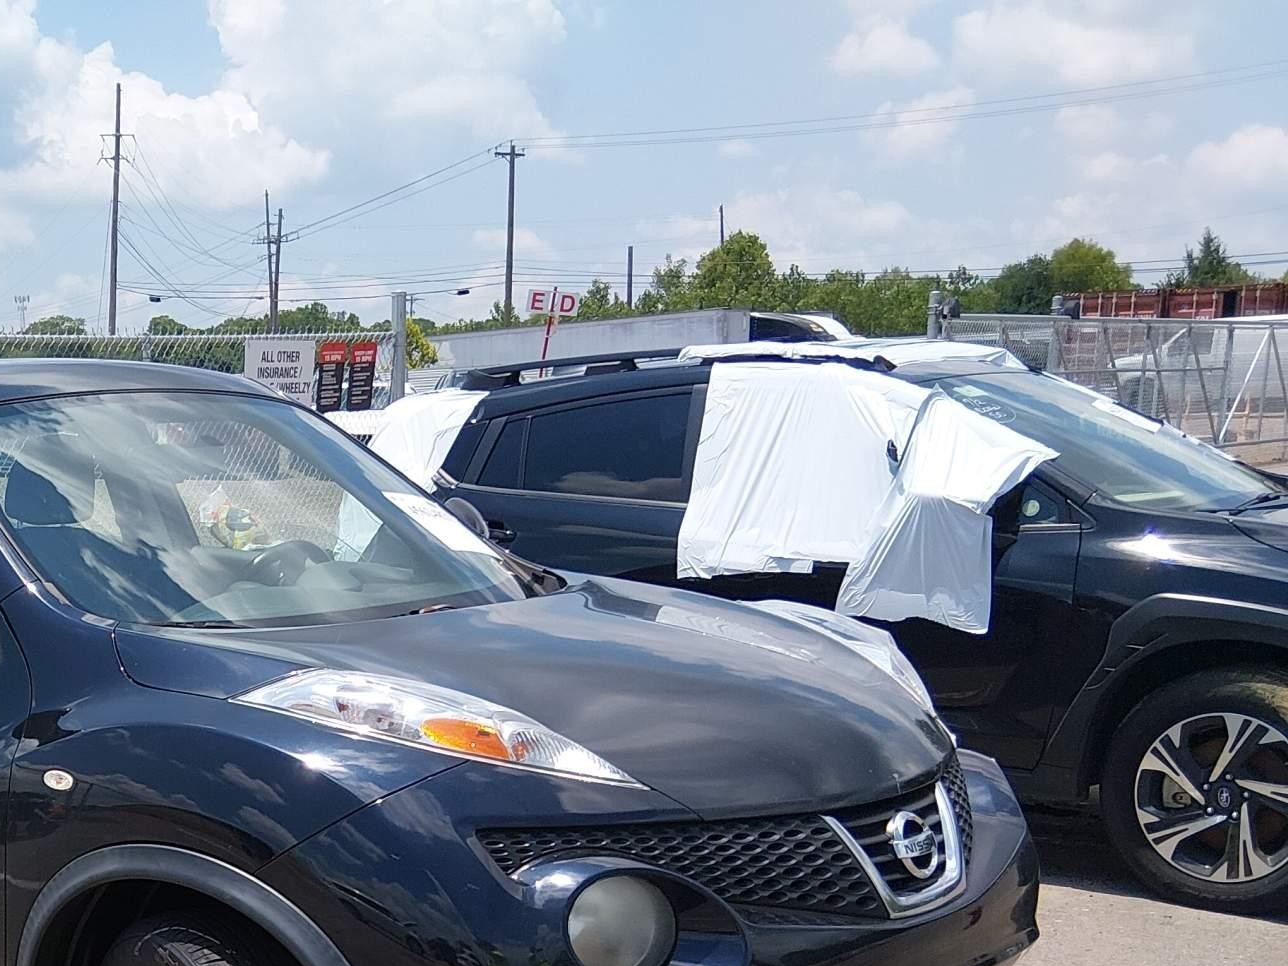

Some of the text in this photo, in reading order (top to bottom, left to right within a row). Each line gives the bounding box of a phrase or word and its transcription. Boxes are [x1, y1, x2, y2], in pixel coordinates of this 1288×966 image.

[531, 292, 545, 310] E
[560, 294, 575, 312] D
[261, 350, 301, 363] ALL OTHER
